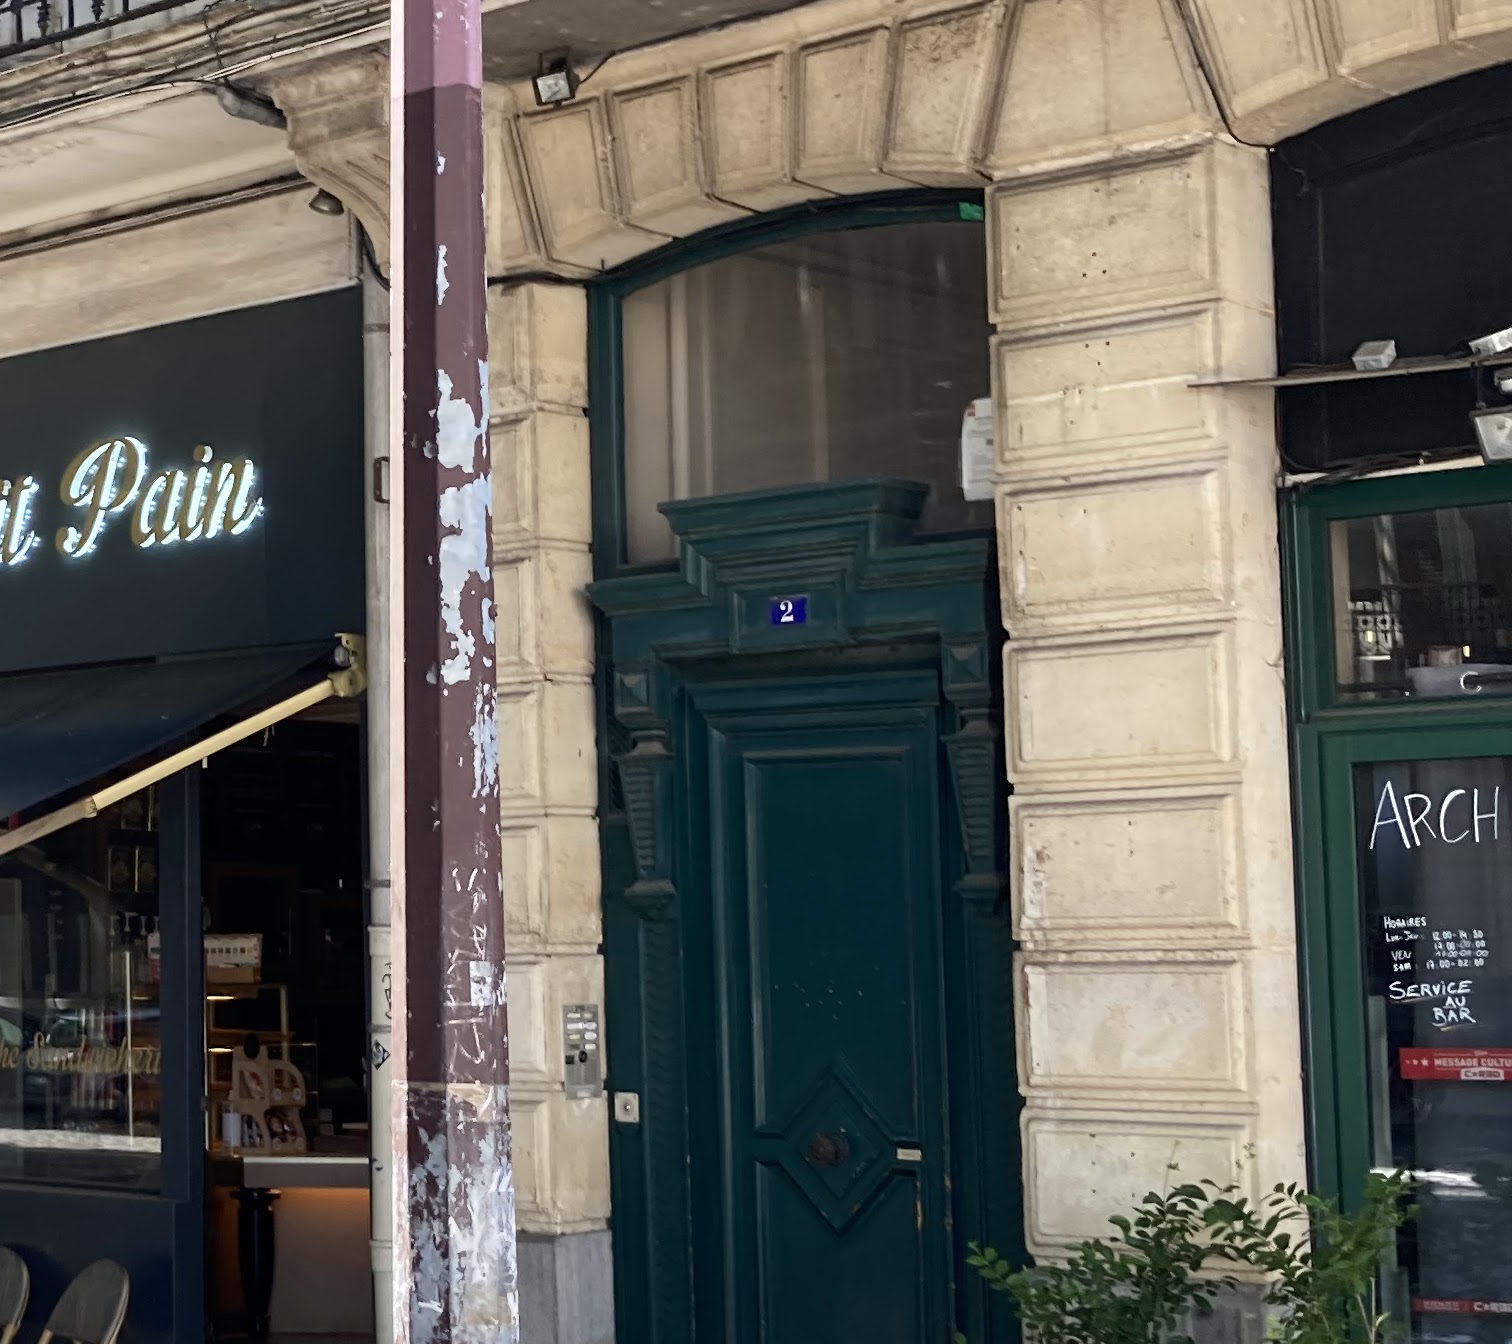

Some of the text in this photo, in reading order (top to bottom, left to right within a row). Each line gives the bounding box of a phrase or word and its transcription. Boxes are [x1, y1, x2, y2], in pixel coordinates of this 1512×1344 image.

[56, 436, 265, 559] Pain
[779, 600, 794, 622] 2
[1431, 1007, 1477, 1027] BAR
